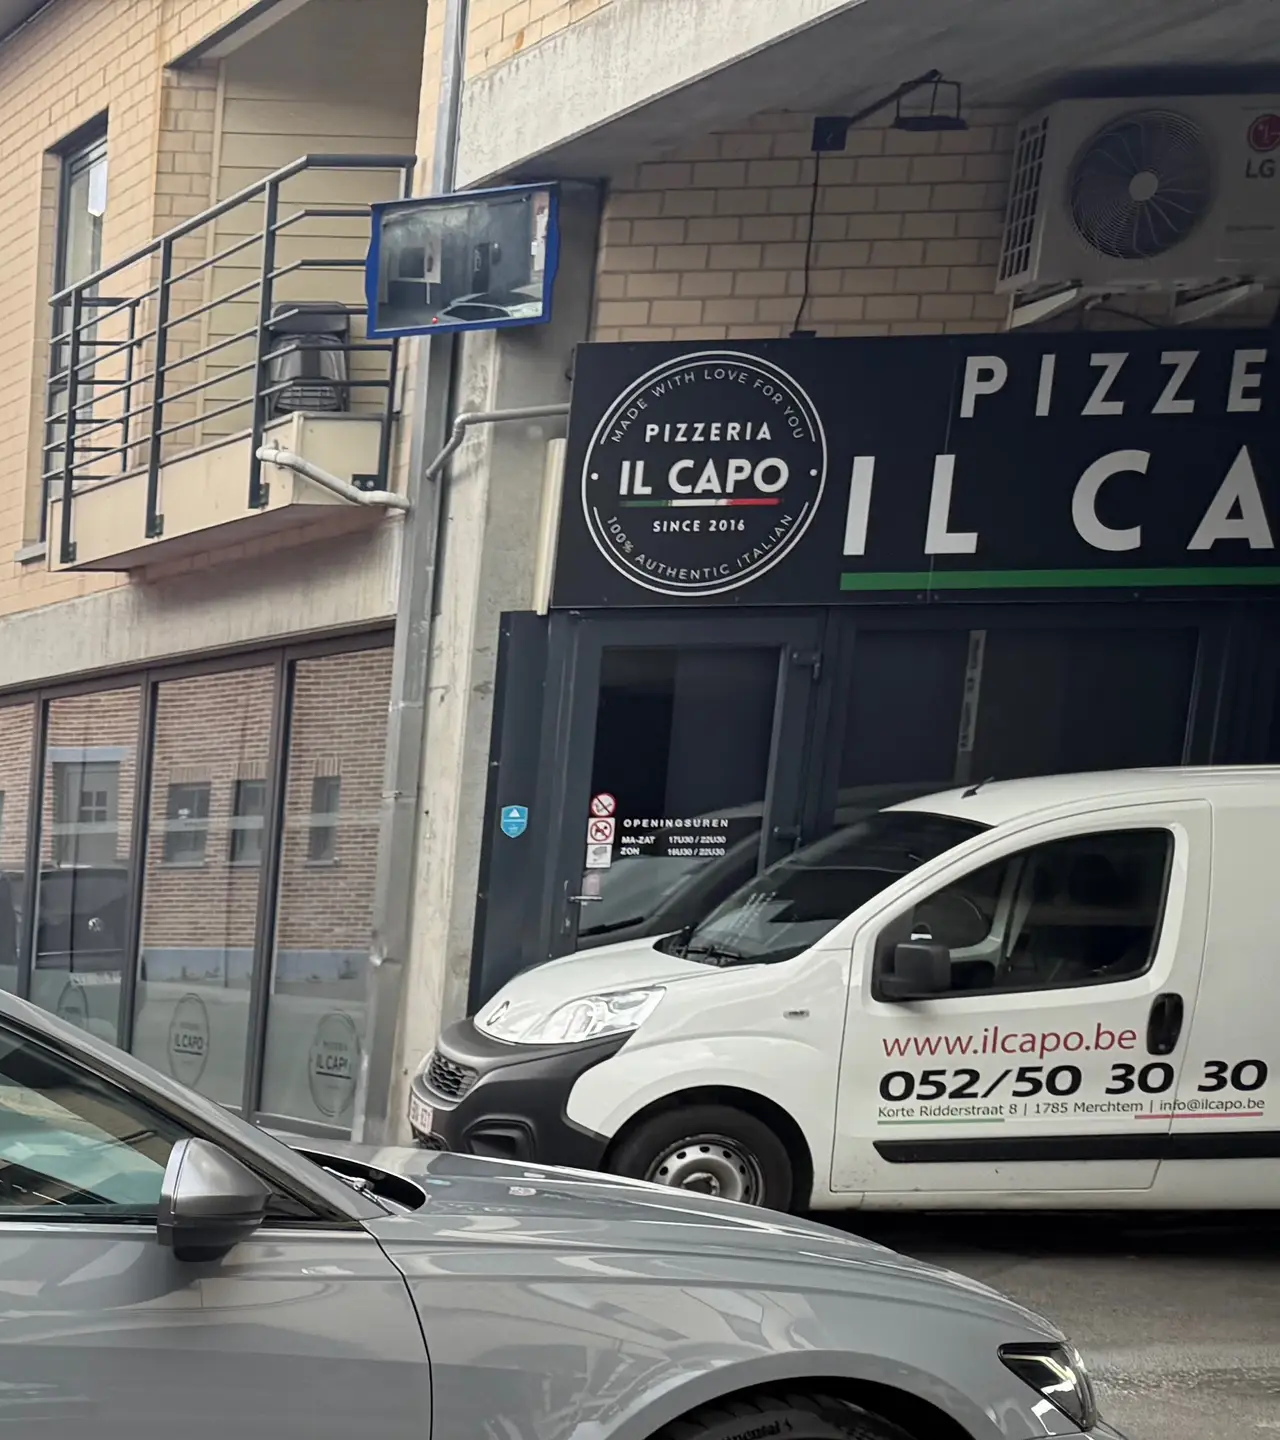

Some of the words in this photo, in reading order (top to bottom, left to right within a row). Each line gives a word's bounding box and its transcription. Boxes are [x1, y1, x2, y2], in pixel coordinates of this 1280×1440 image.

[1245, 157, 1276, 179] LG
[960, 348, 1268, 418] PIZZE
[611, 398, 648, 443] MADE
[651, 371, 695, 398] WITH
[704, 368, 749, 385] LOVE
[753, 378, 783, 405] FOR
[783, 406, 805, 440] YOU
[645, 422, 772, 443] PIZZERIA
[619, 460, 653, 495] IL
[668, 457, 789, 494] CAPO
[843, 454, 978, 556] IL
[1071, 445, 1275, 552] CA
[652, 519, 701, 532] SINCE
[708, 518, 746, 531] 2016
[607, 516, 635, 553] 100%
[635, 553, 730, 580] AUTHENTIC
[736, 514, 793, 568] ITALIAN
[623, 819, 729, 828] OPENINGSUREN
[620, 847, 640, 856] ZON
[621, 836, 656, 844] MA-ZAT
[881, 1023, 1138, 1059] www.ilcapo.be
[879, 1065, 1082, 1101] 052/50
[1105, 1062, 1175, 1095] 30
[1198, 1059, 1268, 1092] 30
[878, 1105, 915, 1118] Korte
[919, 1103, 1005, 1117] Ridderstraat
[1009, 1104, 1018, 1115] 8
[1034, 1103, 1069, 1115] 1785
[1074, 1100, 1143, 1114] Merchtem
[1159, 1098, 1265, 1112] info@ilcapo.be
